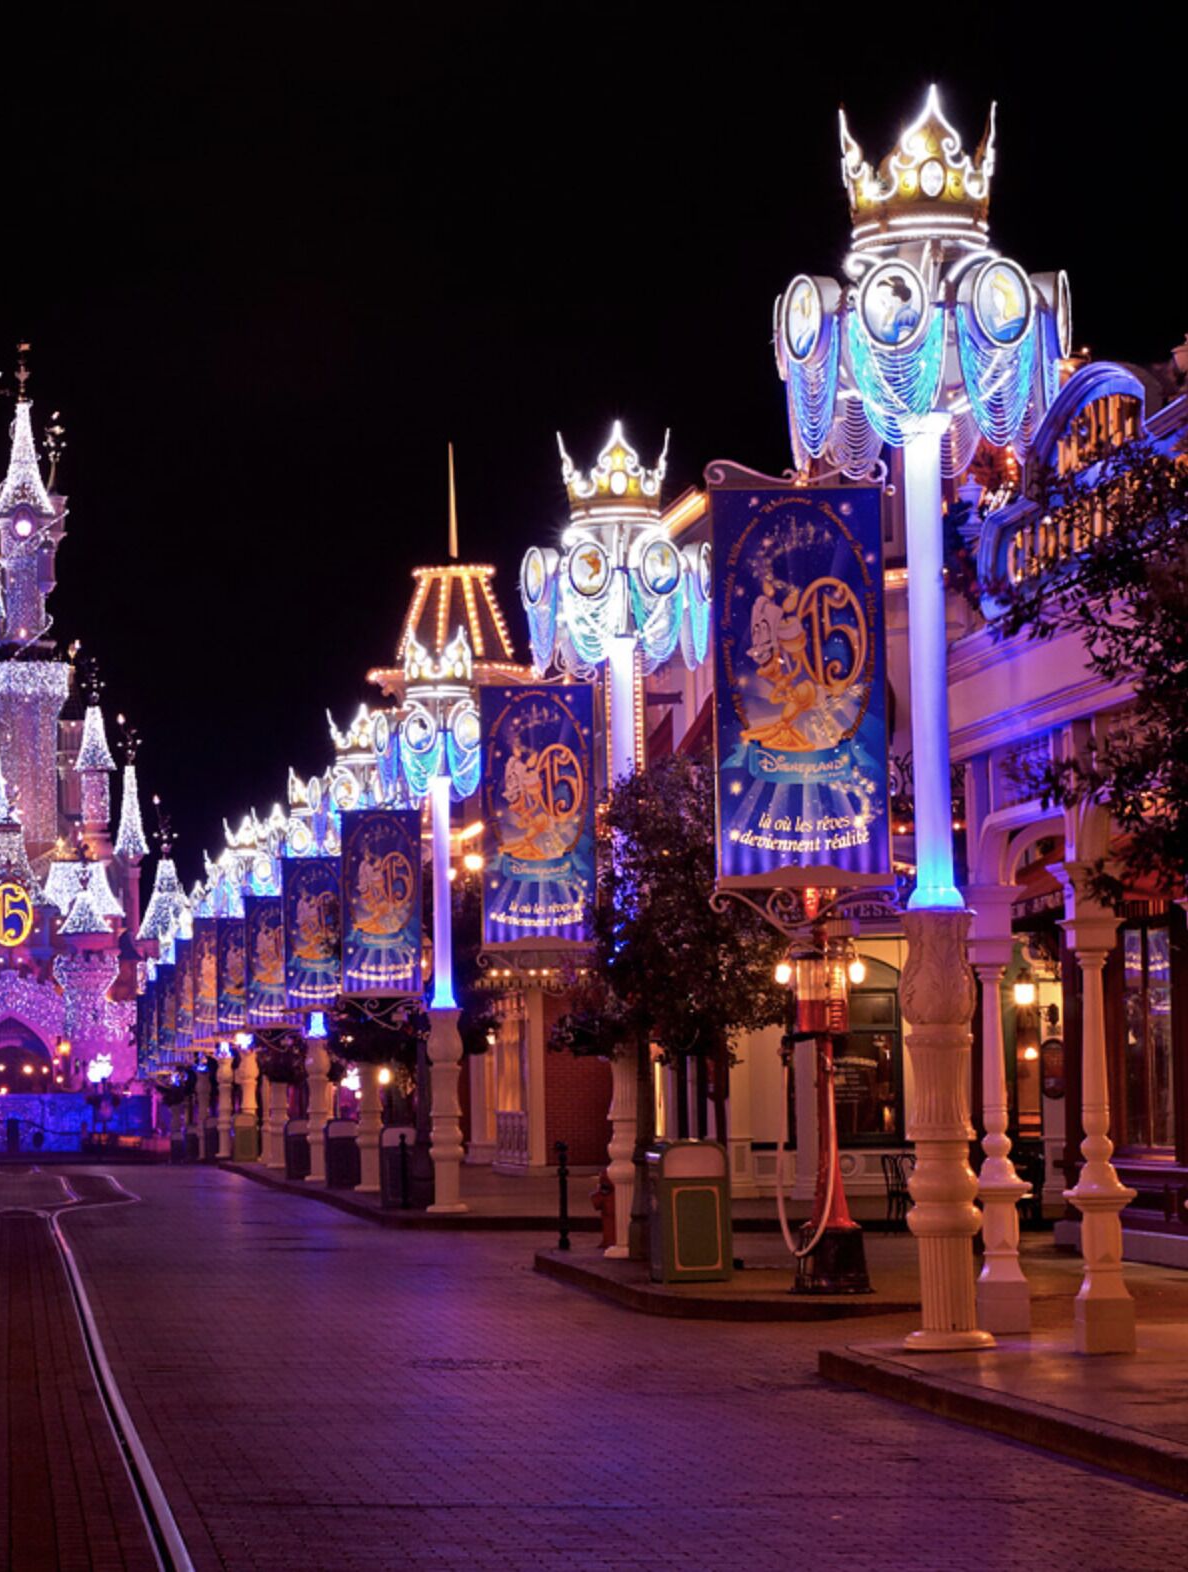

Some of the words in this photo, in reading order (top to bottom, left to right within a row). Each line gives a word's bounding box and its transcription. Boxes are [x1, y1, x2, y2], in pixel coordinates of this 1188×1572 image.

[797, 577, 867, 690] 15
[538, 744, 583, 817] 15
[740, 829, 820, 853] deviennent
[758, 812, 772, 829] là
[774, 816, 791, 832] où
[795, 815, 813, 833] les
